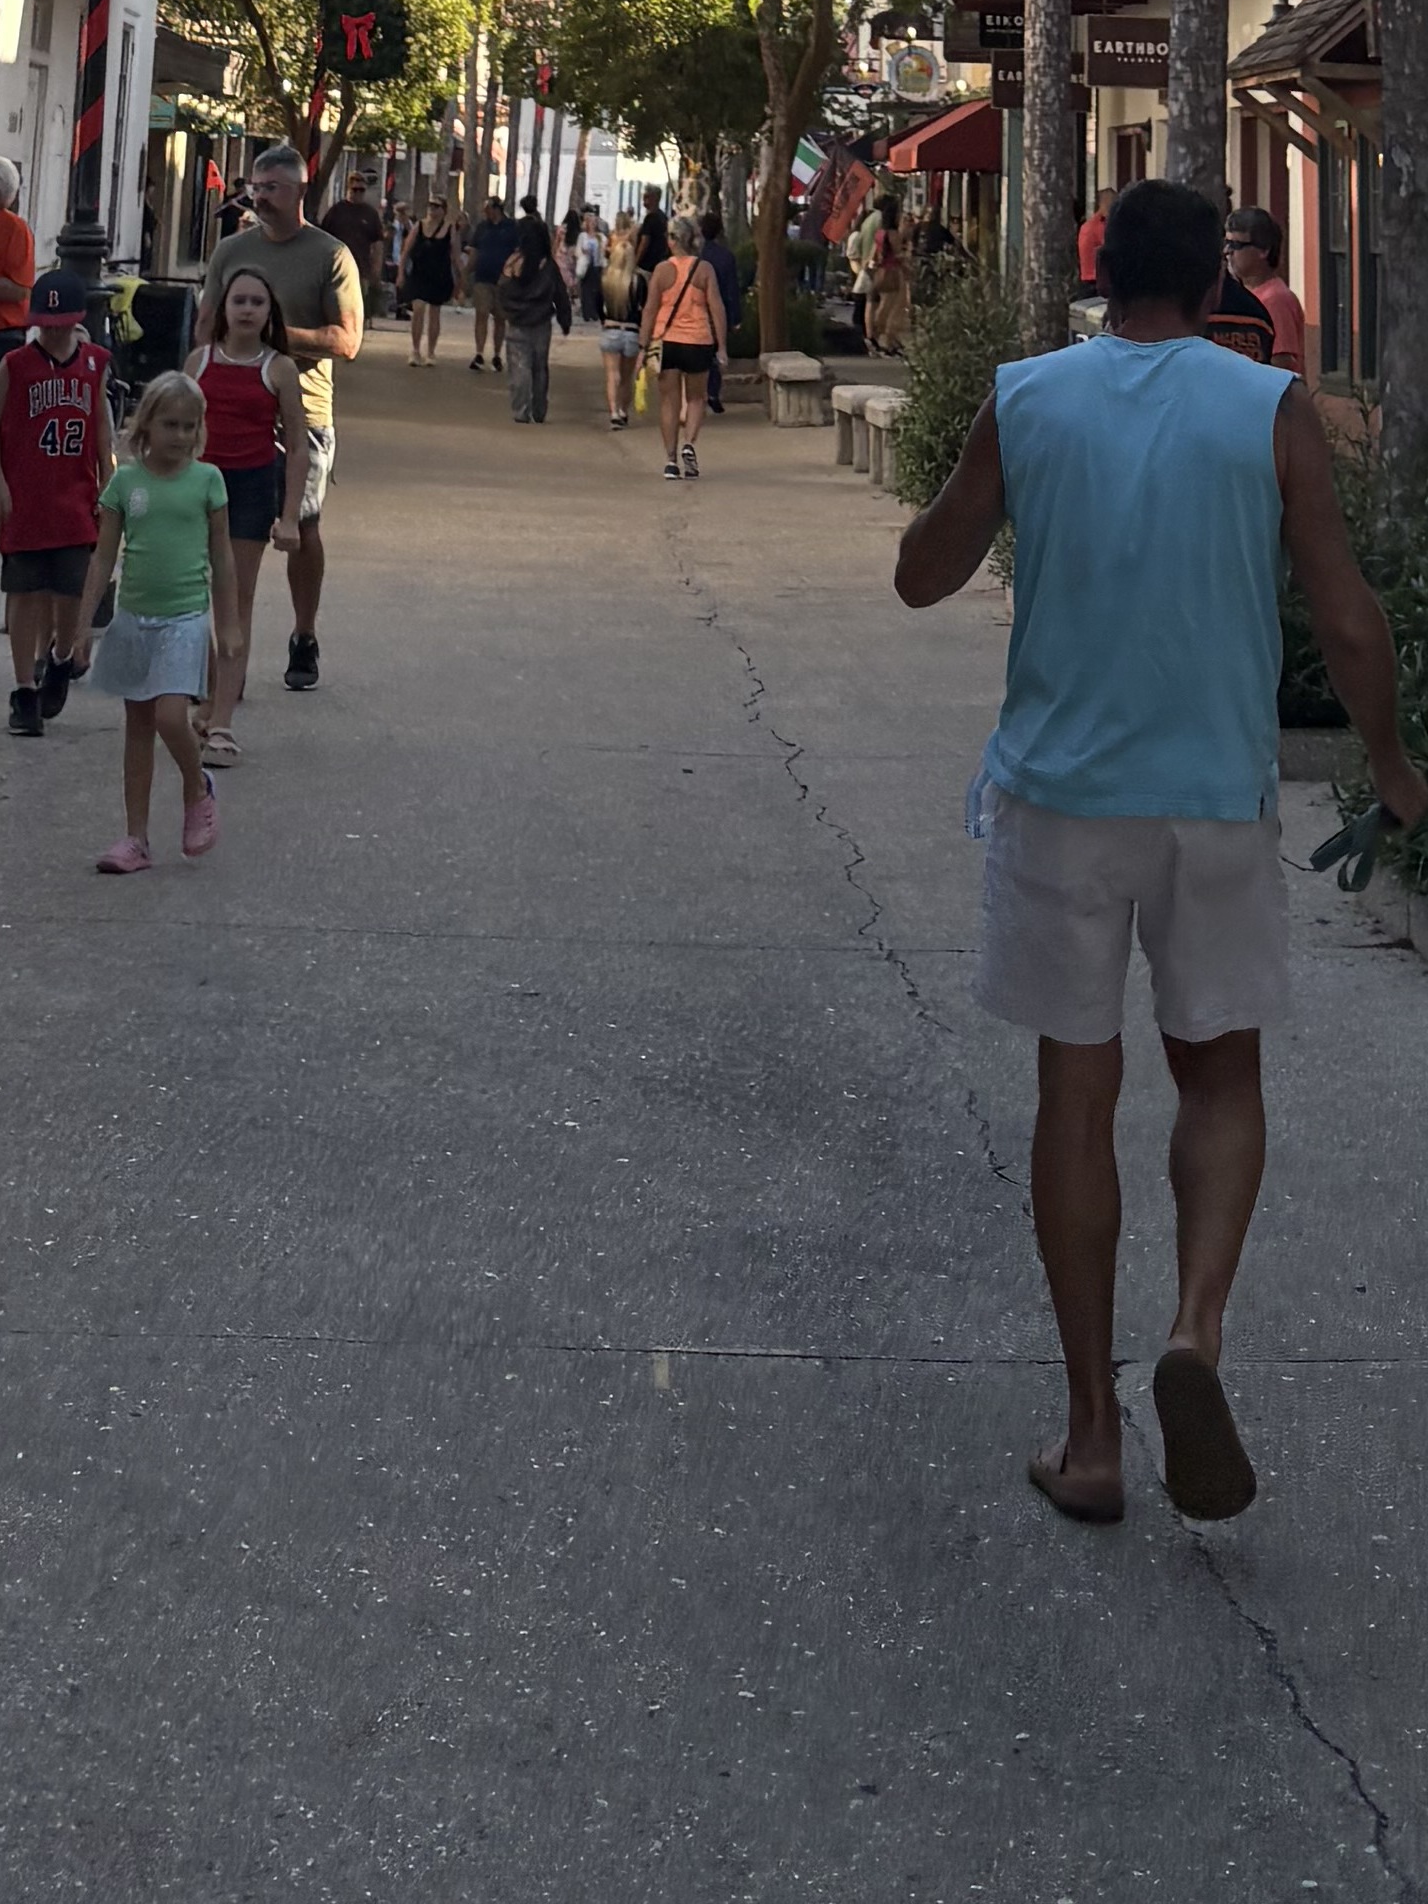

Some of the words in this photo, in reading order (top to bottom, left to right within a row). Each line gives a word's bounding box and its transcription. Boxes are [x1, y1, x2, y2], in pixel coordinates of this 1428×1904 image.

[1093, 40, 1169, 56] EARTHBO
[48, 290, 59, 308] B
[39, 418, 85, 457] 42
